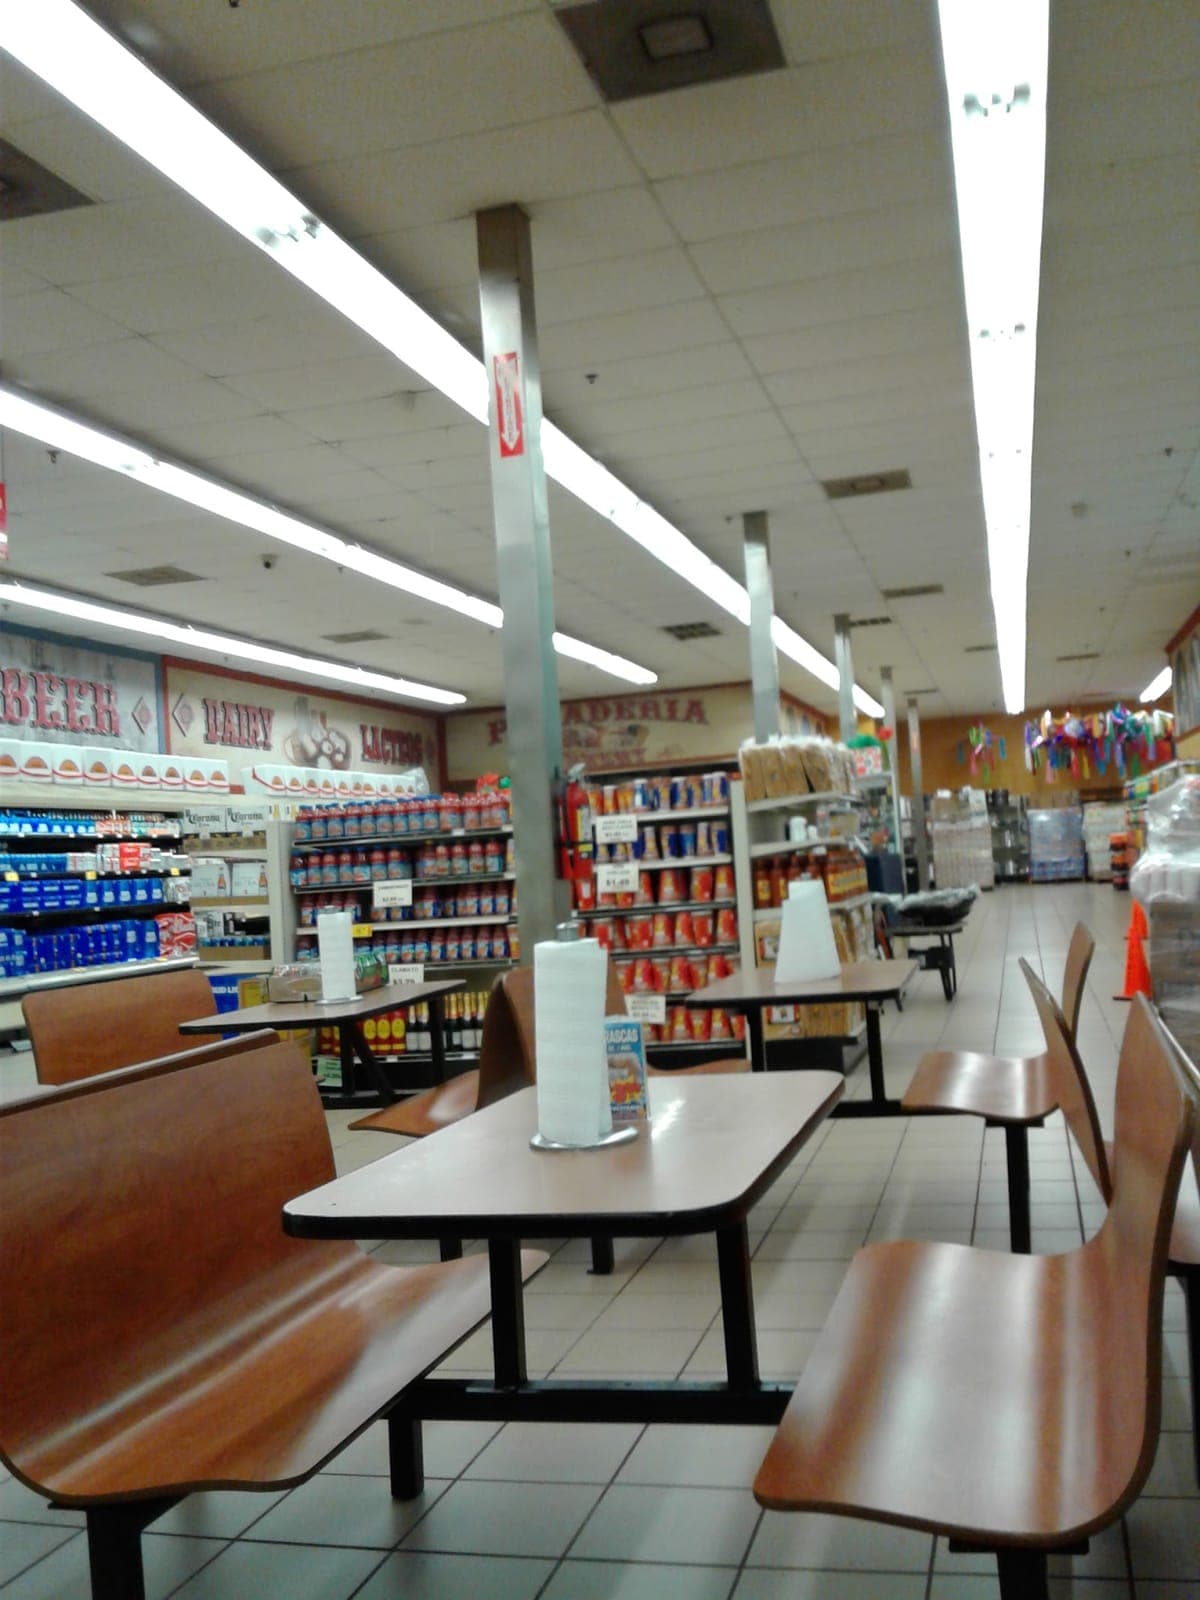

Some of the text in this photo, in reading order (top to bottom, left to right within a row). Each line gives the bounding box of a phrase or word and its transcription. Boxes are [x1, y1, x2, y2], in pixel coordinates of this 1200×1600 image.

[1, 668, 120, 737] BEER
[203, 698, 274, 750] DAIRY
[188, 814, 221, 825] Corona
[230, 811, 264, 823] Corona
